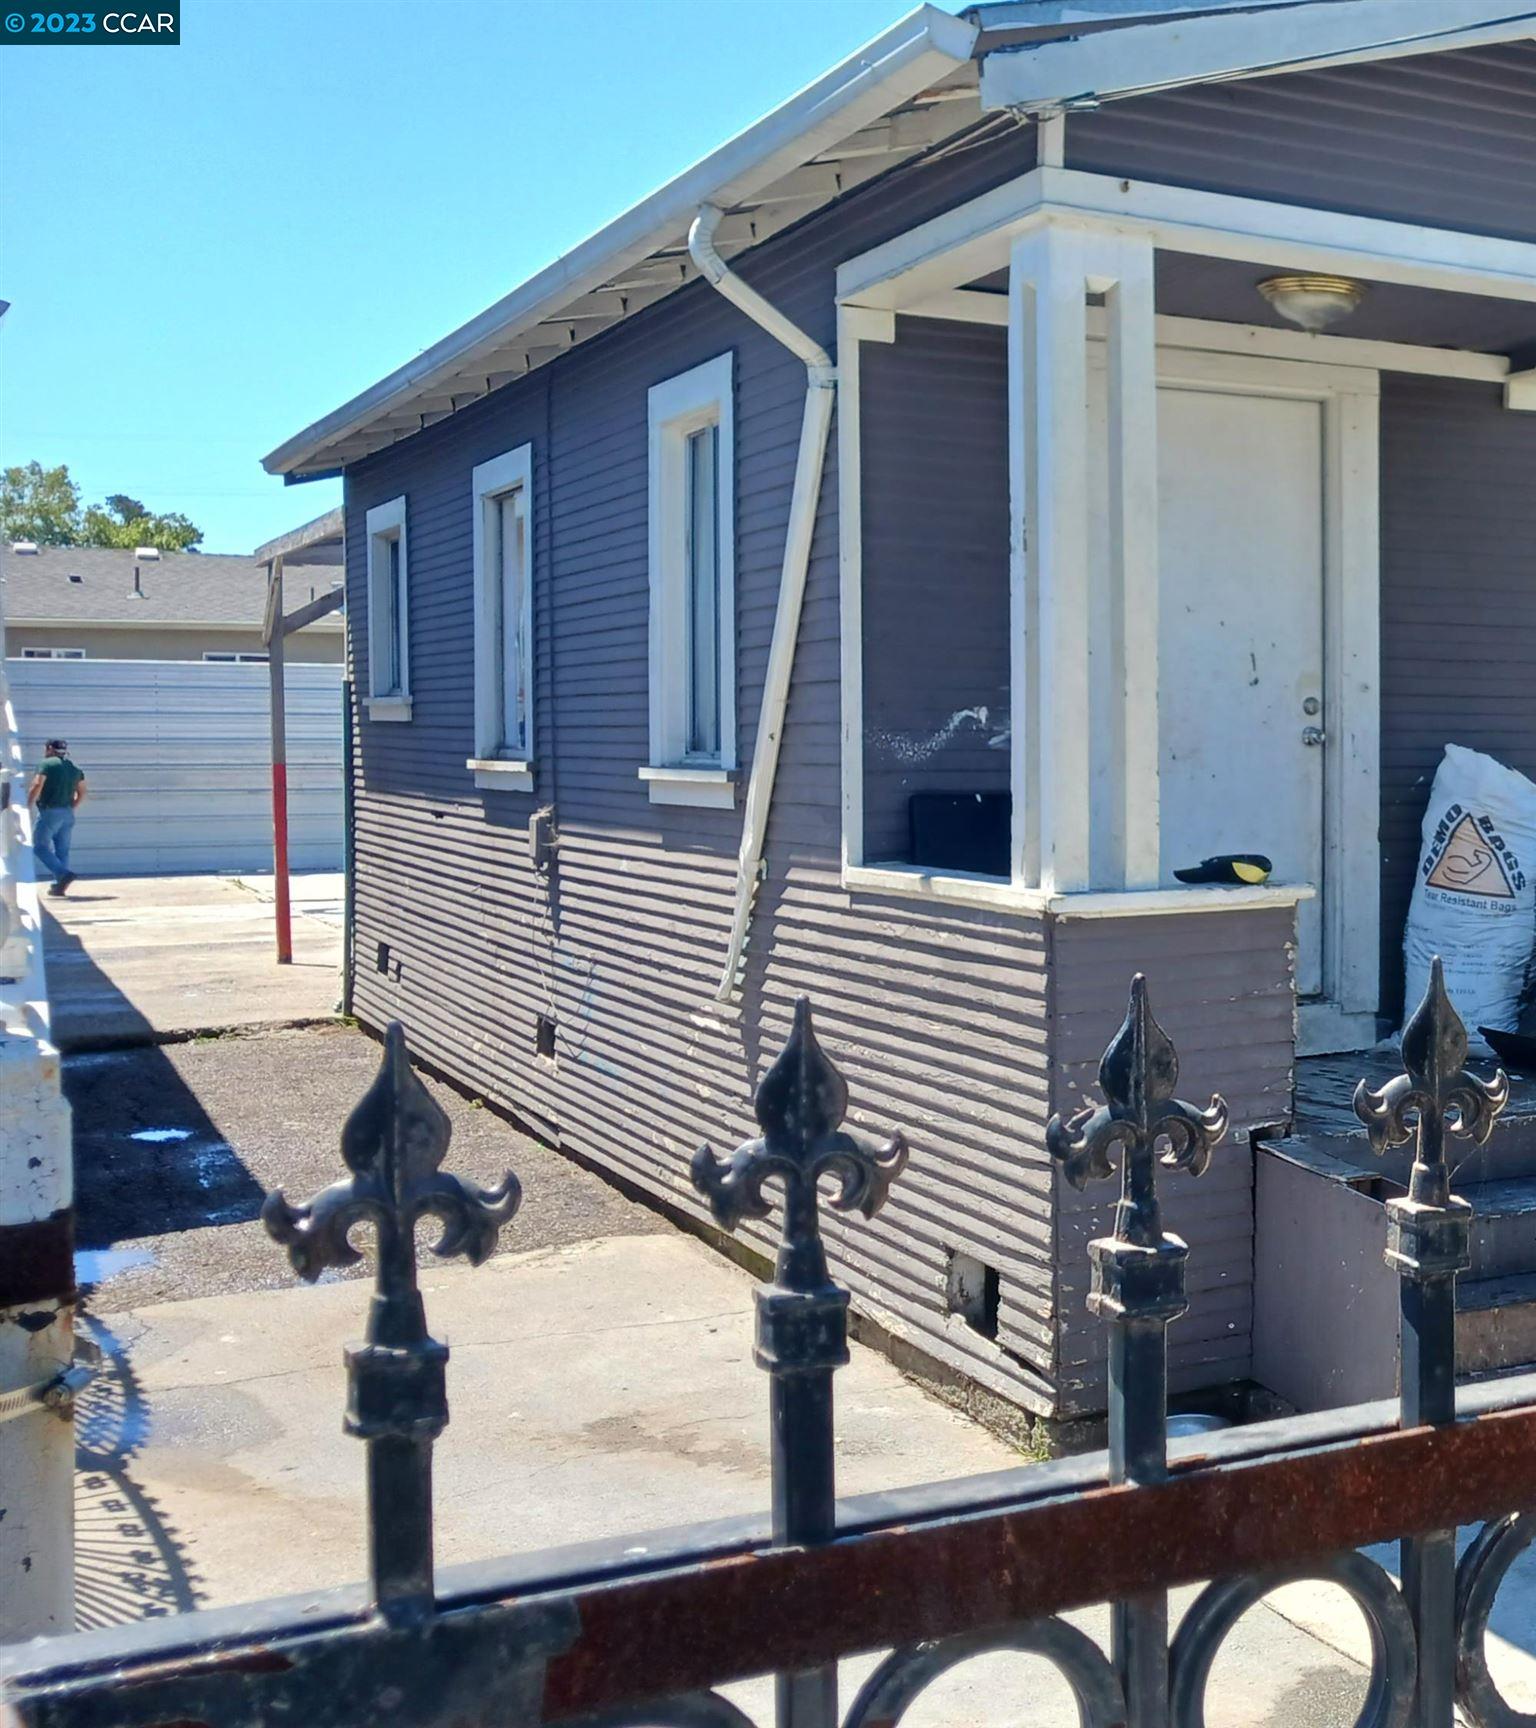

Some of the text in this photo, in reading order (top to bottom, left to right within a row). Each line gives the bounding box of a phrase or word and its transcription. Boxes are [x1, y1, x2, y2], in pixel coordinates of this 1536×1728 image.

[1422, 803, 1526, 891] DEMO BAGS
[1440, 892, 1487, 909] Resistant
[1490, 900, 1517, 913] Bags
